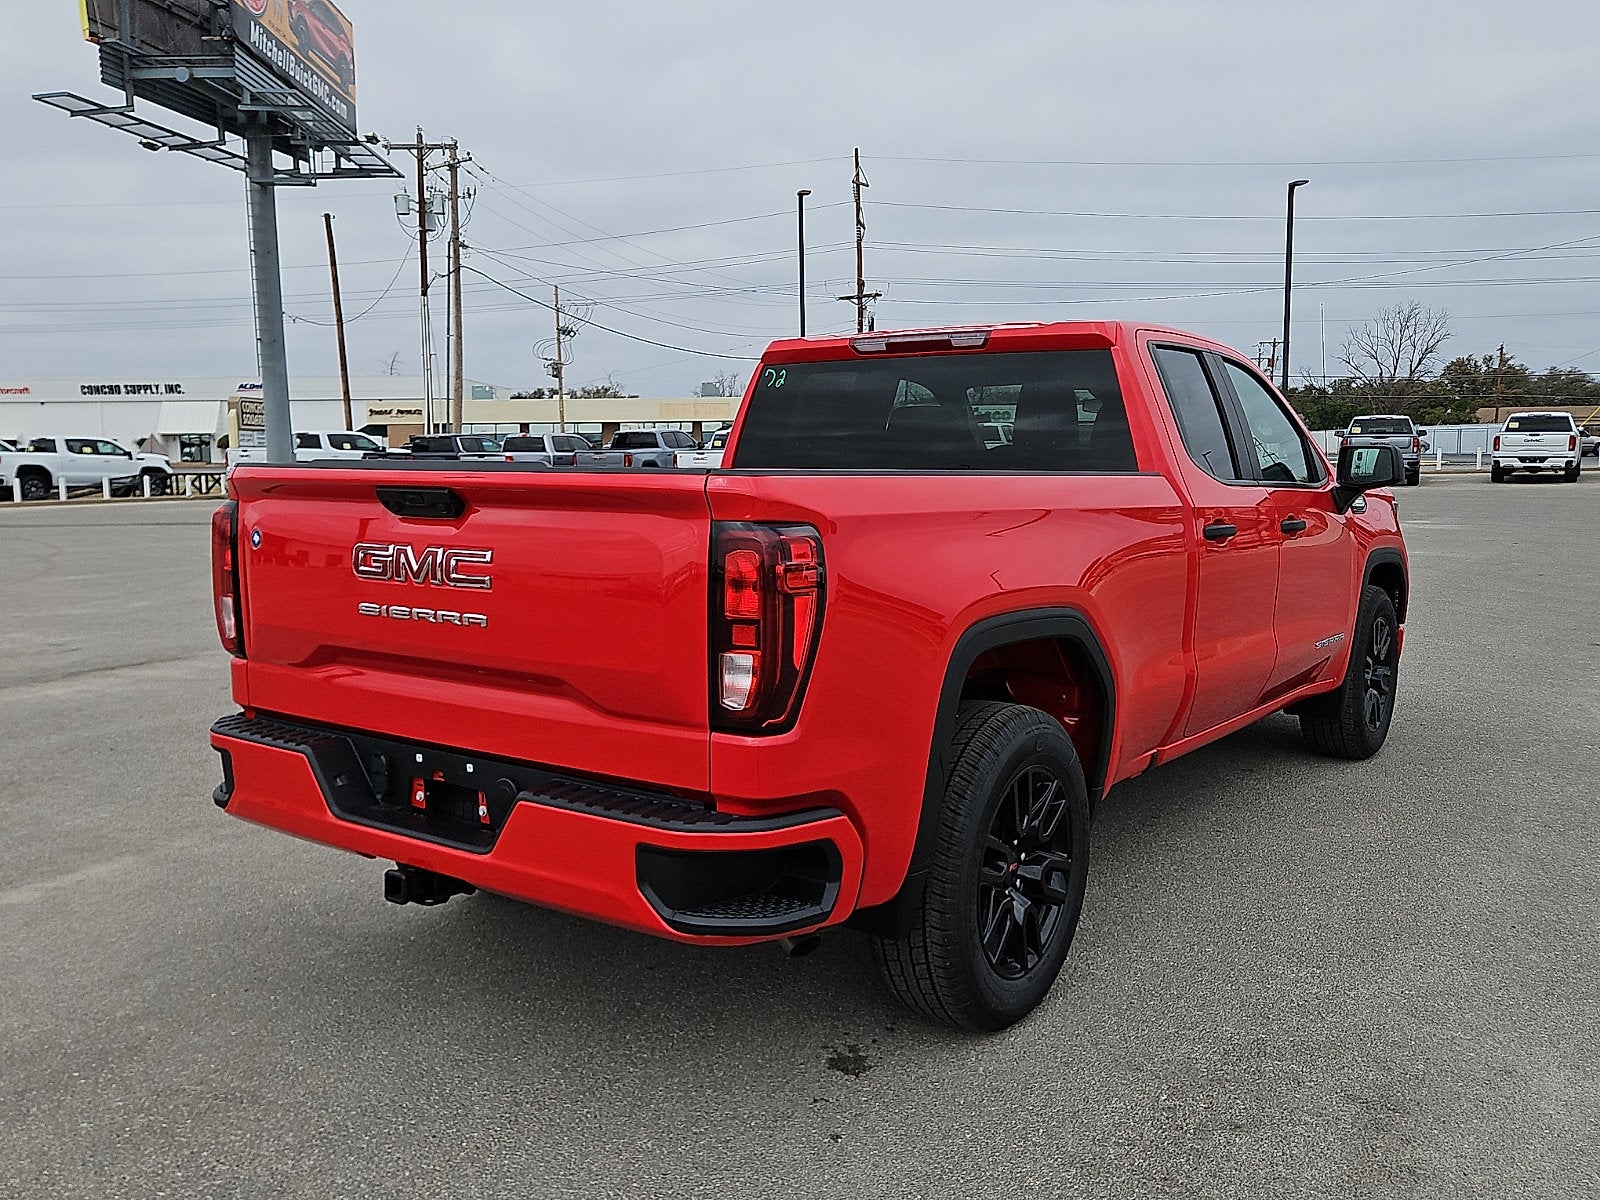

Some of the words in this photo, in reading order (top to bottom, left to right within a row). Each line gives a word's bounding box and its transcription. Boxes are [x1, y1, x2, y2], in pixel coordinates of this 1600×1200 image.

[250, 20, 348, 120] MitchellBuickGMC.com
[80, 384, 122, 395] CONCHO
[164, 384, 186, 395] INC.
[764, 368, 787, 388] 72
[352, 542, 493, 589] GMC
[358, 602, 488, 628] SIERRA
